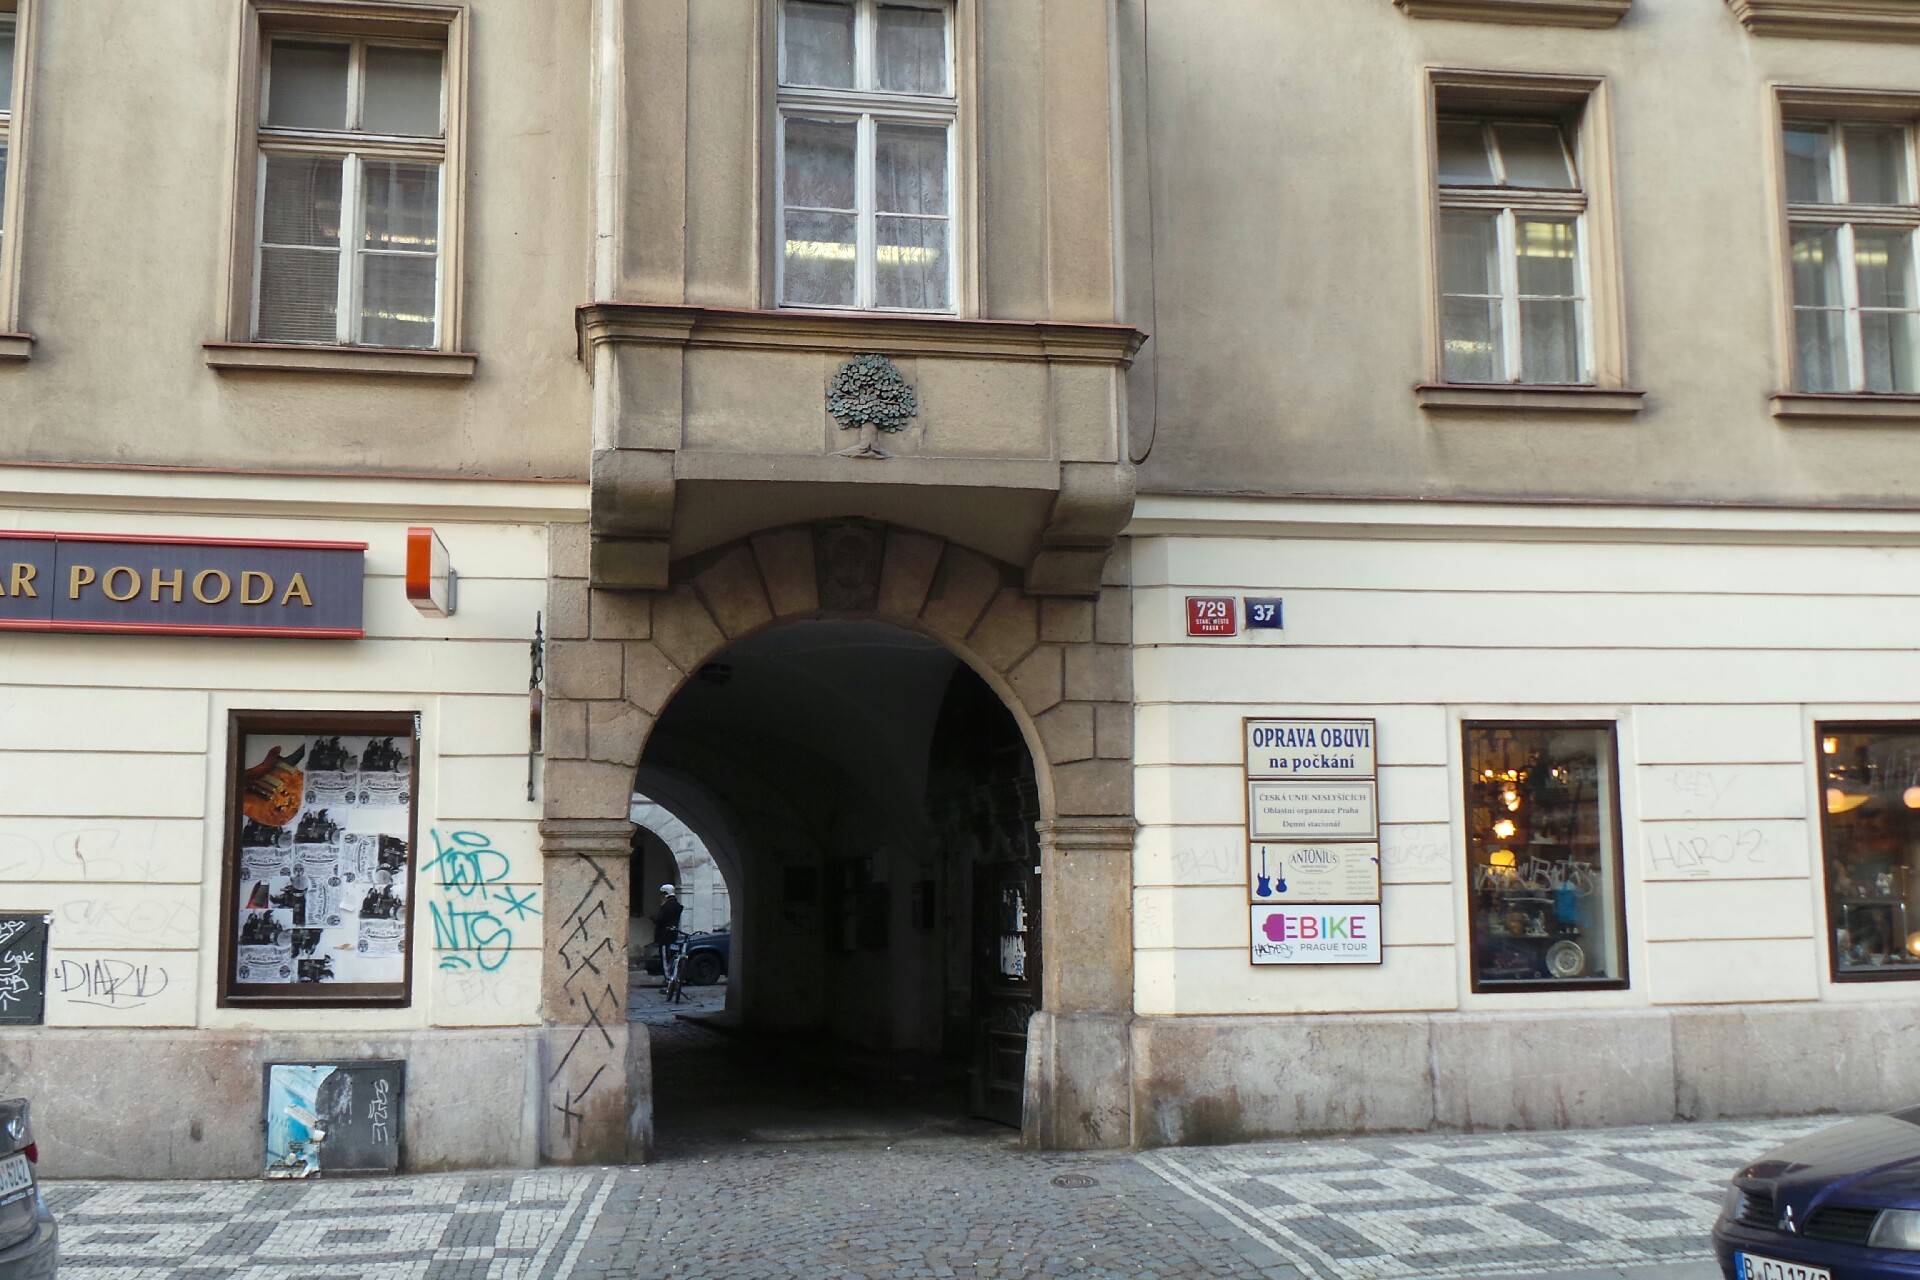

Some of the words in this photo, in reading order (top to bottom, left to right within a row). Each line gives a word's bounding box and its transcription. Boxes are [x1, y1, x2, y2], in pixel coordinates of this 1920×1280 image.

[69, 565, 312, 606] POHODA
[1197, 601, 1226, 617] 729
[1253, 604, 1274, 621] 37
[1252, 727, 1316, 748] OPRAVA
[1321, 728, 1369, 748] OBUVI
[1269, 757, 1288, 768] na
[1292, 753, 1354, 772] počkání
[1259, 792, 1286, 801] ČESKÁ
[1312, 792, 1366, 801] NESLYŠÍCÍCH
[1263, 806, 1295, 814] Oblastní
[1296, 806, 1335, 816] organizace
[1337, 806, 1359, 814] Praha
[1282, 820, 1306, 828] Denní
[1307, 820, 1341, 828] stacionář
[1291, 848, 1337, 864] ANTONIUS
[1285, 916, 1366, 939] EBIKE
[1300, 942, 1339, 951] PRAGUE
[1340, 942, 1367, 951] TOUR
